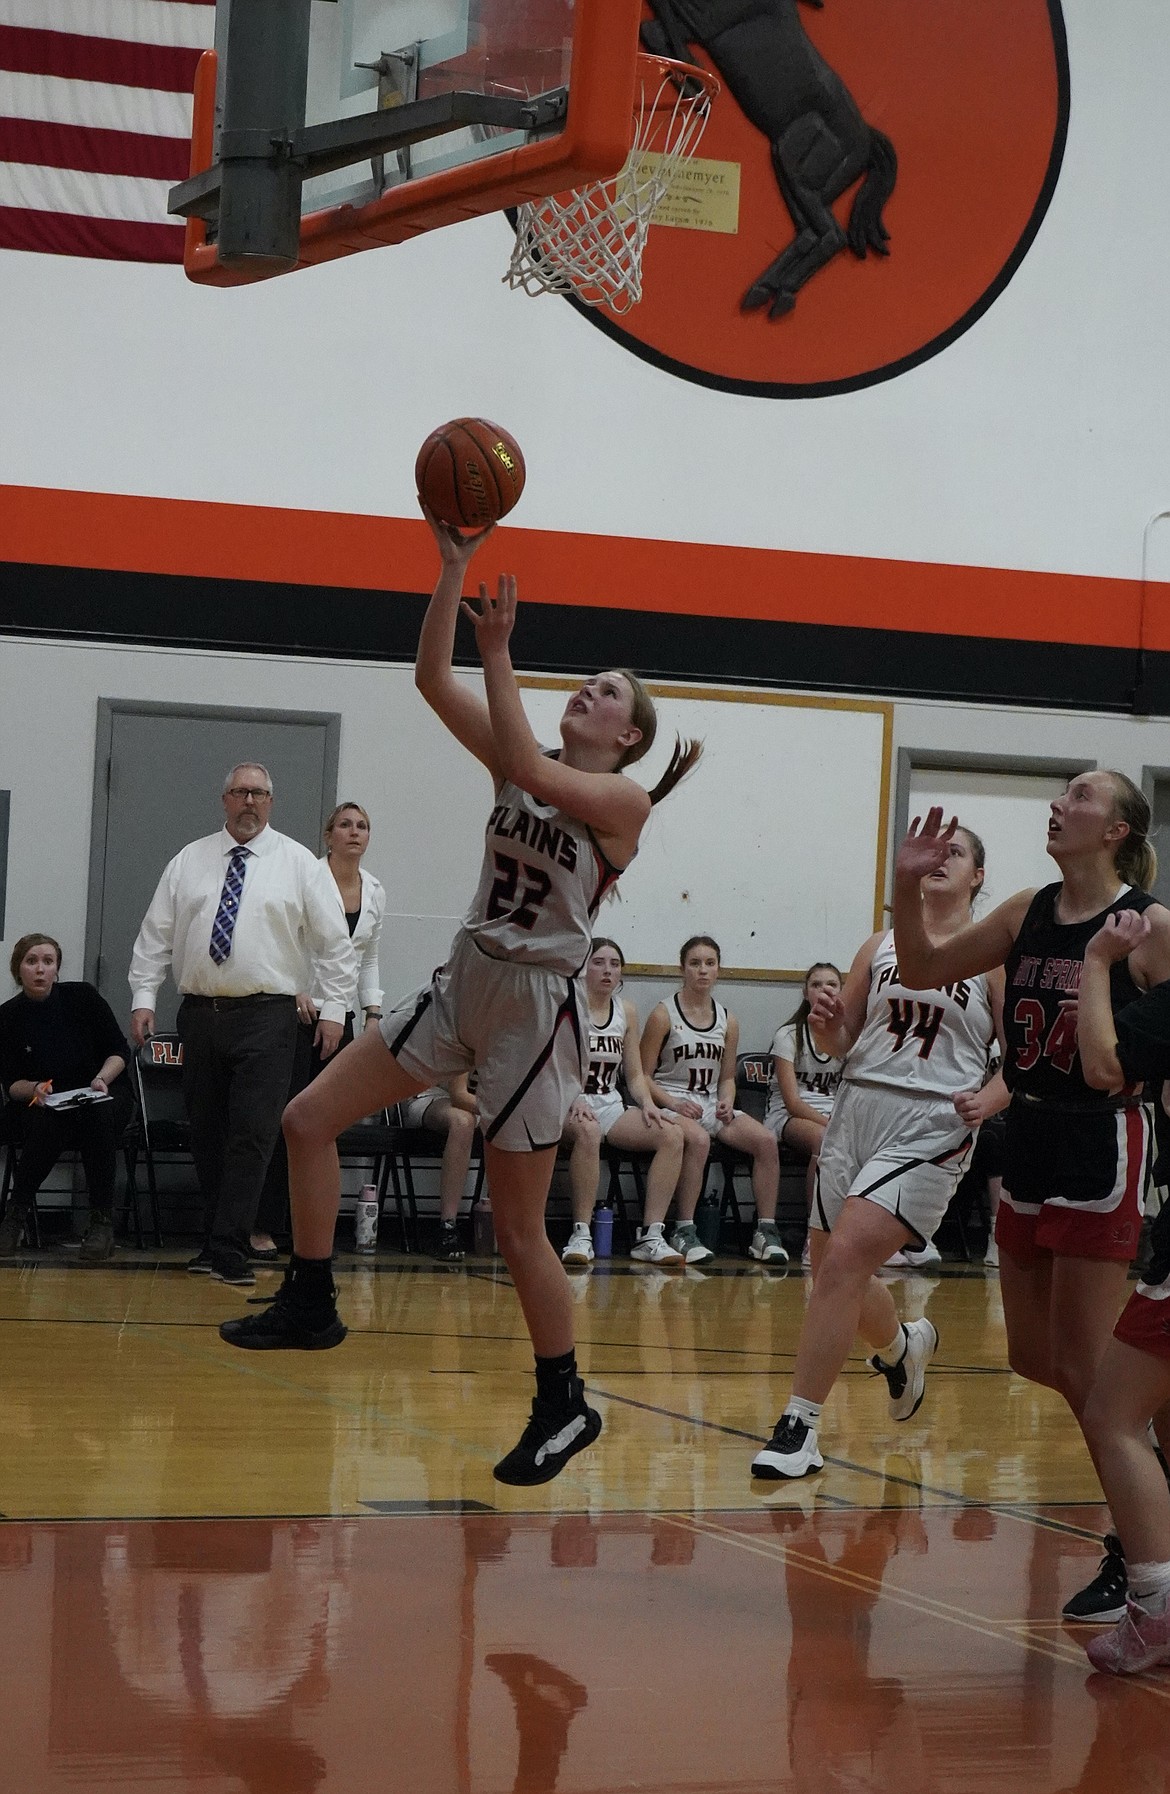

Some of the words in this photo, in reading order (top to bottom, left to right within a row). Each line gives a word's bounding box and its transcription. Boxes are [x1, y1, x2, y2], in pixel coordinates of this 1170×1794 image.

[485, 849, 552, 931] 22
[886, 997, 946, 1061] 44
[1014, 998, 1080, 1075] 34
[150, 1041, 184, 1066] PL
[672, 1042, 726, 1063] PLAIN
[743, 1061, 773, 1084] PL
